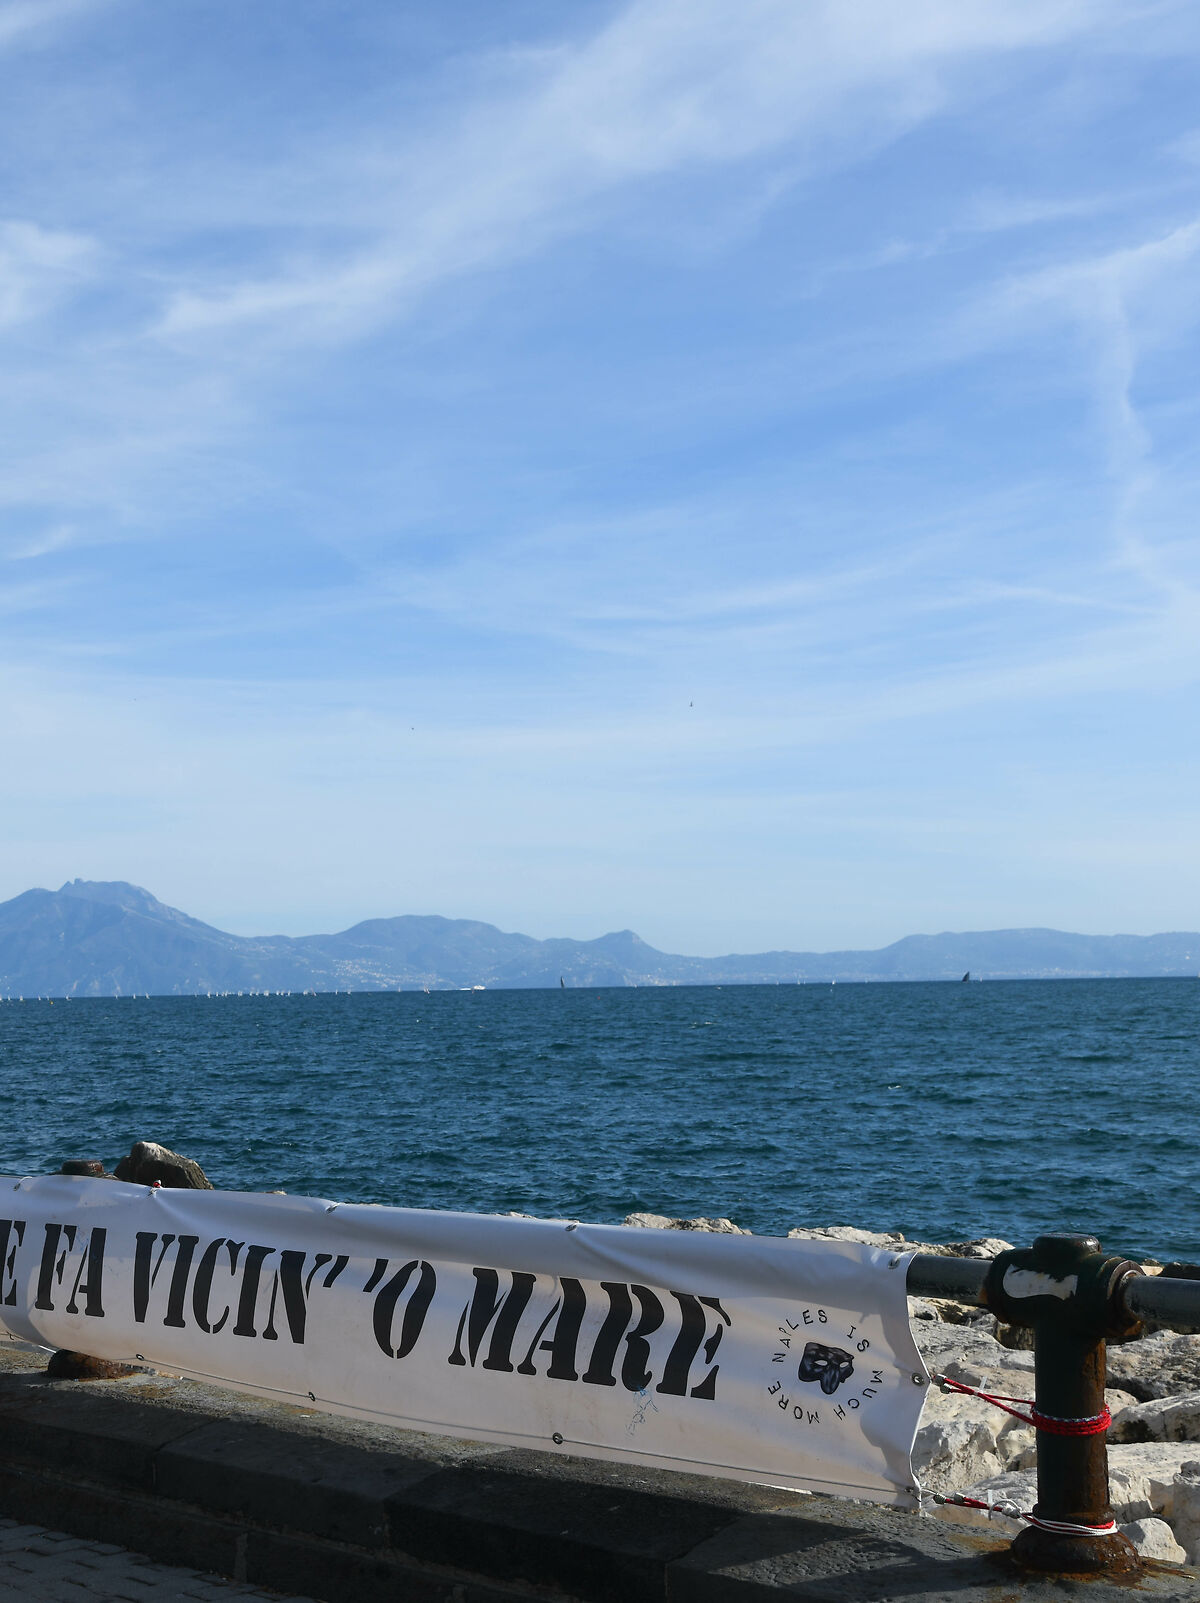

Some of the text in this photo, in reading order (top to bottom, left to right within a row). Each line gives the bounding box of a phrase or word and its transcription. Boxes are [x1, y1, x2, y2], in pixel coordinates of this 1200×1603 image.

[34, 1223, 108, 1317] FA
[133, 1231, 350, 1345] VICIN'
[363, 1258, 437, 1360] 'O
[448, 1267, 732, 1401] MARE
[846, 1325, 870, 1352] IS
[767, 1380, 820, 1424] MORE
[833, 1370, 883, 1420] MUCH
